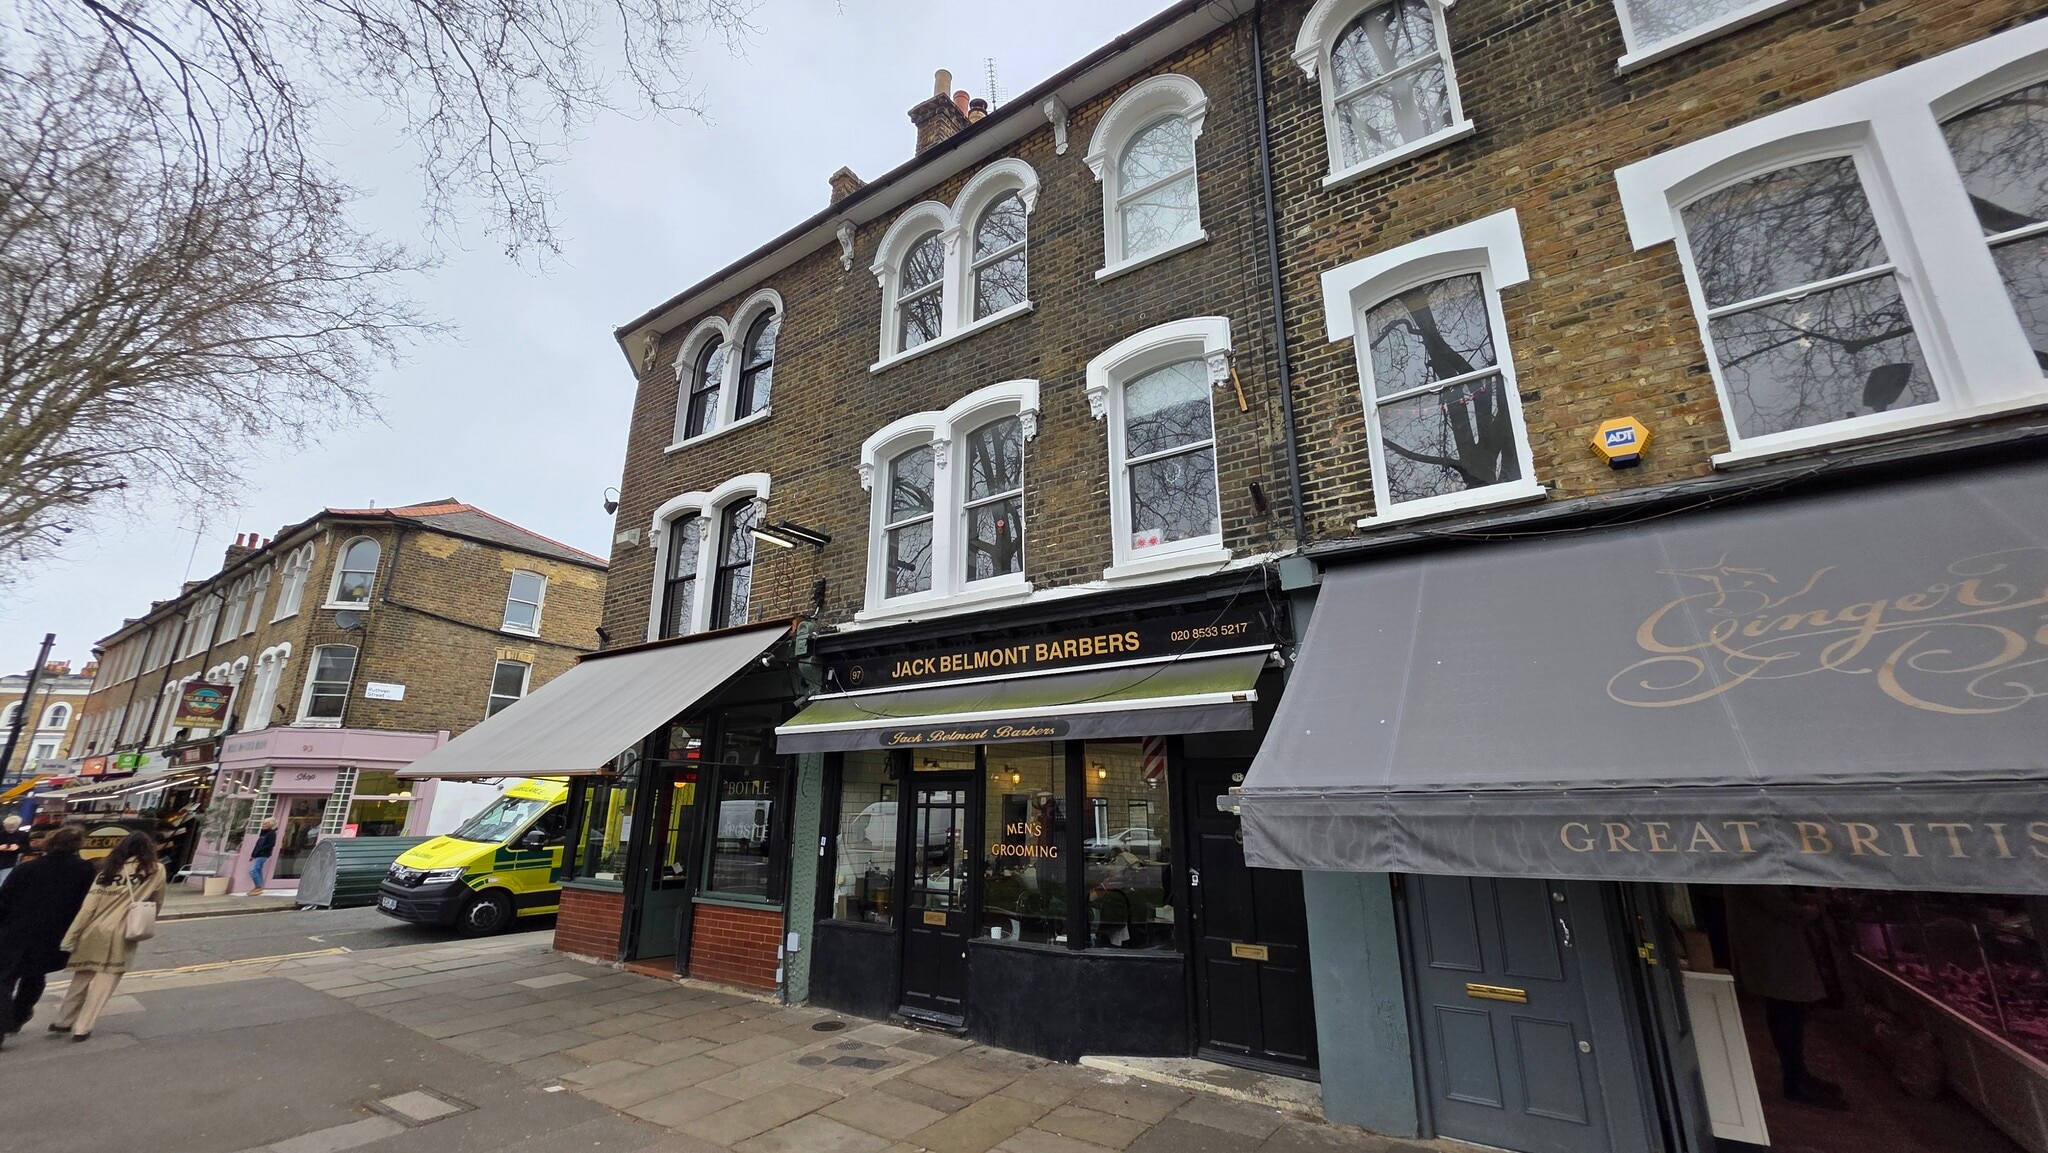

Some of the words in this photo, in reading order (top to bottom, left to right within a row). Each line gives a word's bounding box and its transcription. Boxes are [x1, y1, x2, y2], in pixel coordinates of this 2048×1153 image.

[1607, 429, 1634, 444] ADT
[1170, 630, 1190, 642] 020
[1192, 626, 1219, 639] 8533
[1221, 622, 1248, 636] 5217
[892, 657, 936, 678] JACK
[940, 645, 1031, 673] BELMONT
[1035, 631, 1140, 662] BARBERS
[851, 670, 861, 680] 97
[888, 732, 923, 746] Jack
[927, 729, 989, 743] Belmont
[993, 725, 1056, 738] Barbers
[294, 772, 316, 782] Shop
[728, 780, 771, 795] BOTTLE
[1006, 822, 1042, 837] MEN'S
[1560, 821, 1760, 853] GREAT
[991, 843, 1058, 858] GROOMING
